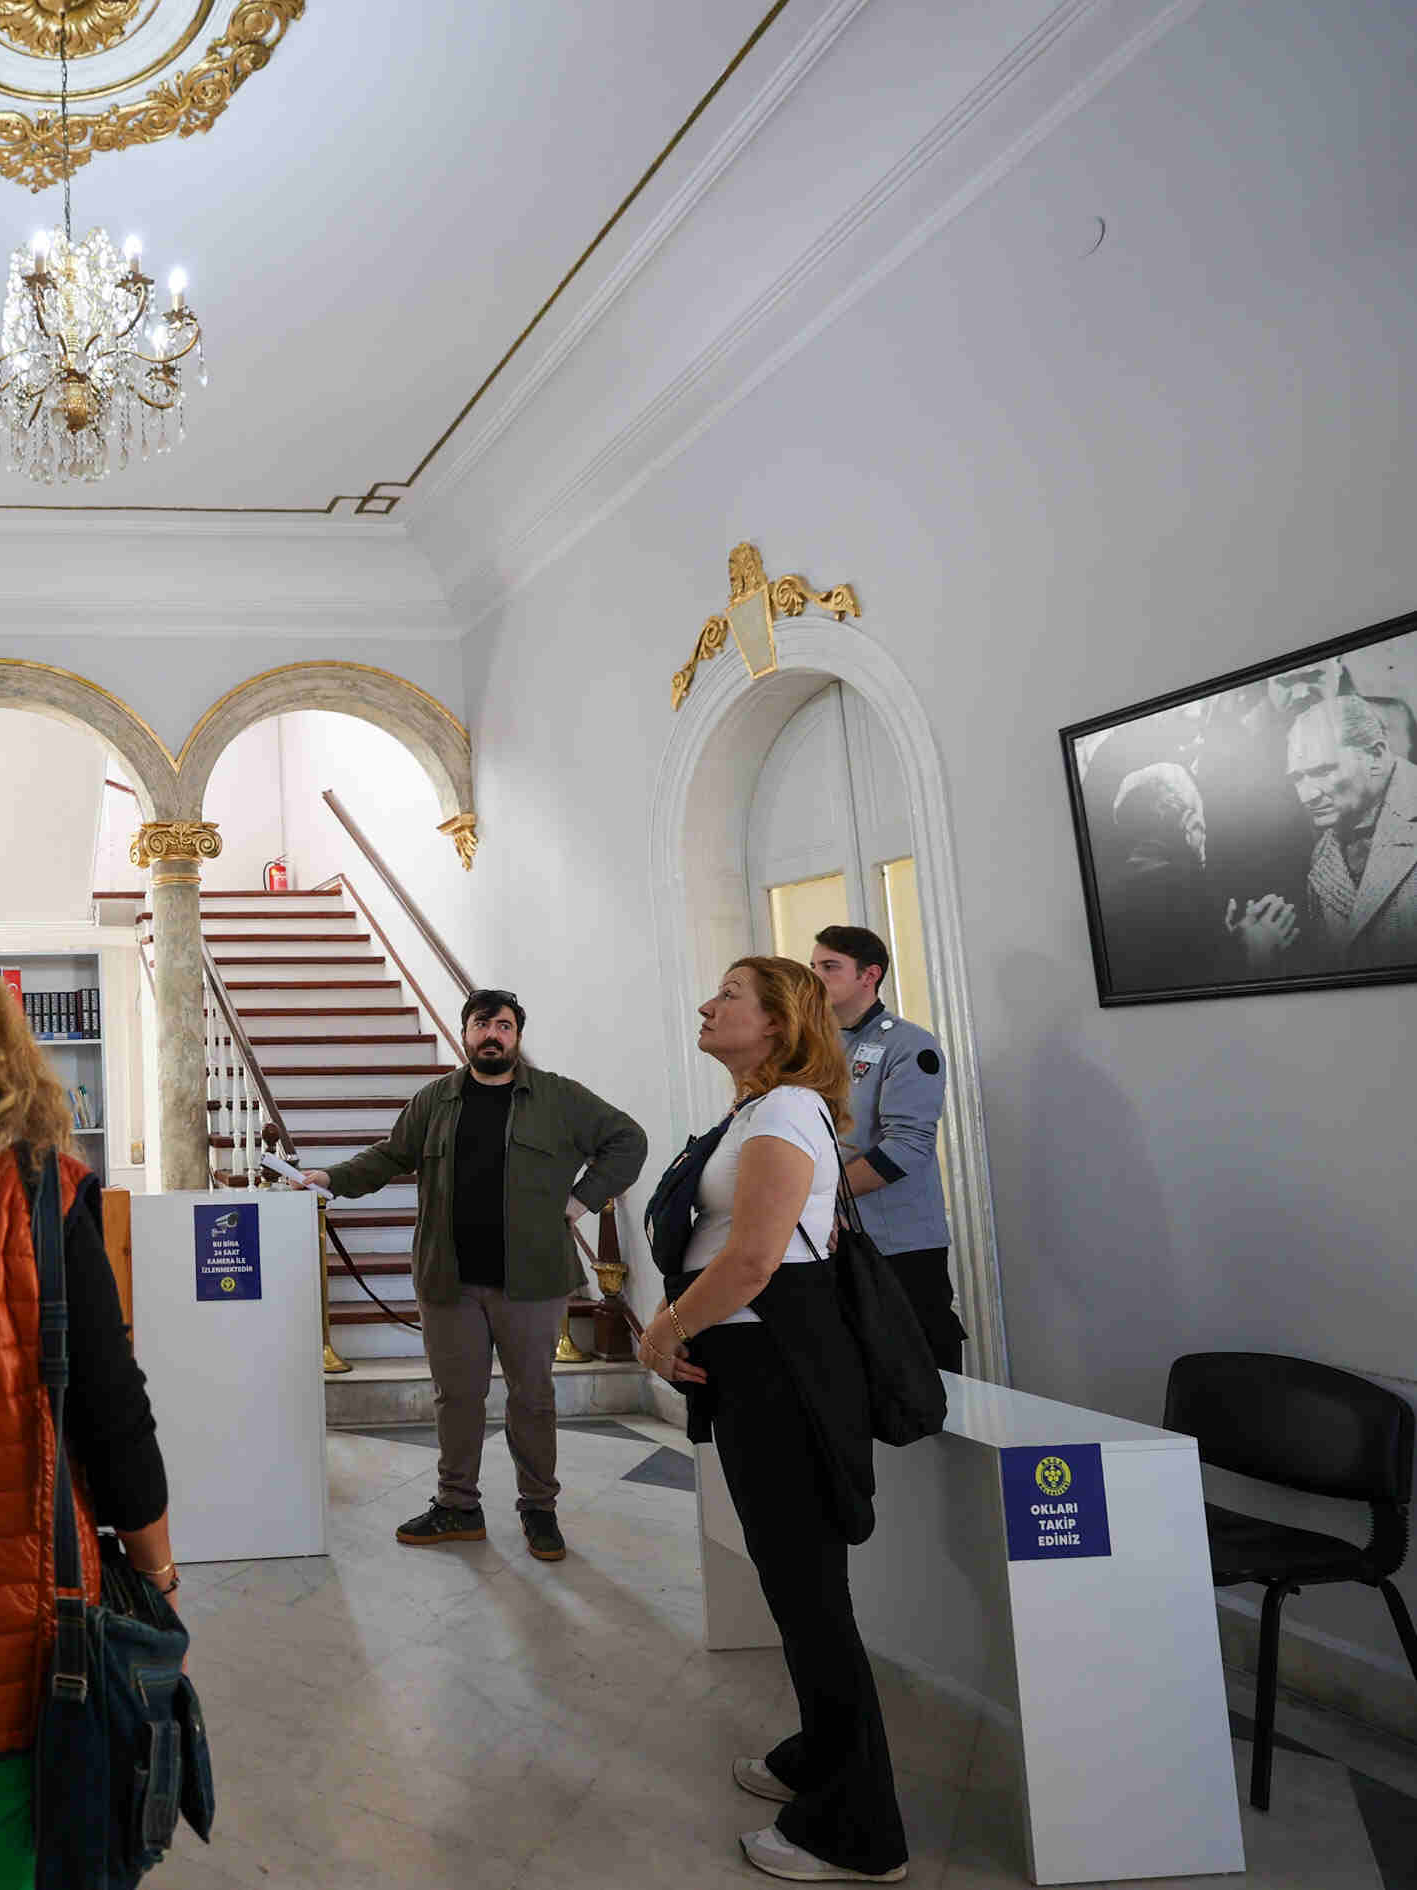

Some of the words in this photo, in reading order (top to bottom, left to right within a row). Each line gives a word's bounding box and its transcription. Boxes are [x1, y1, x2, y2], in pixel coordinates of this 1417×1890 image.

[1030, 1502, 1078, 1515] OKLARI
[1038, 1516, 1076, 1530] TAKİP
[1038, 1532, 1081, 1546] EDİNİZ
